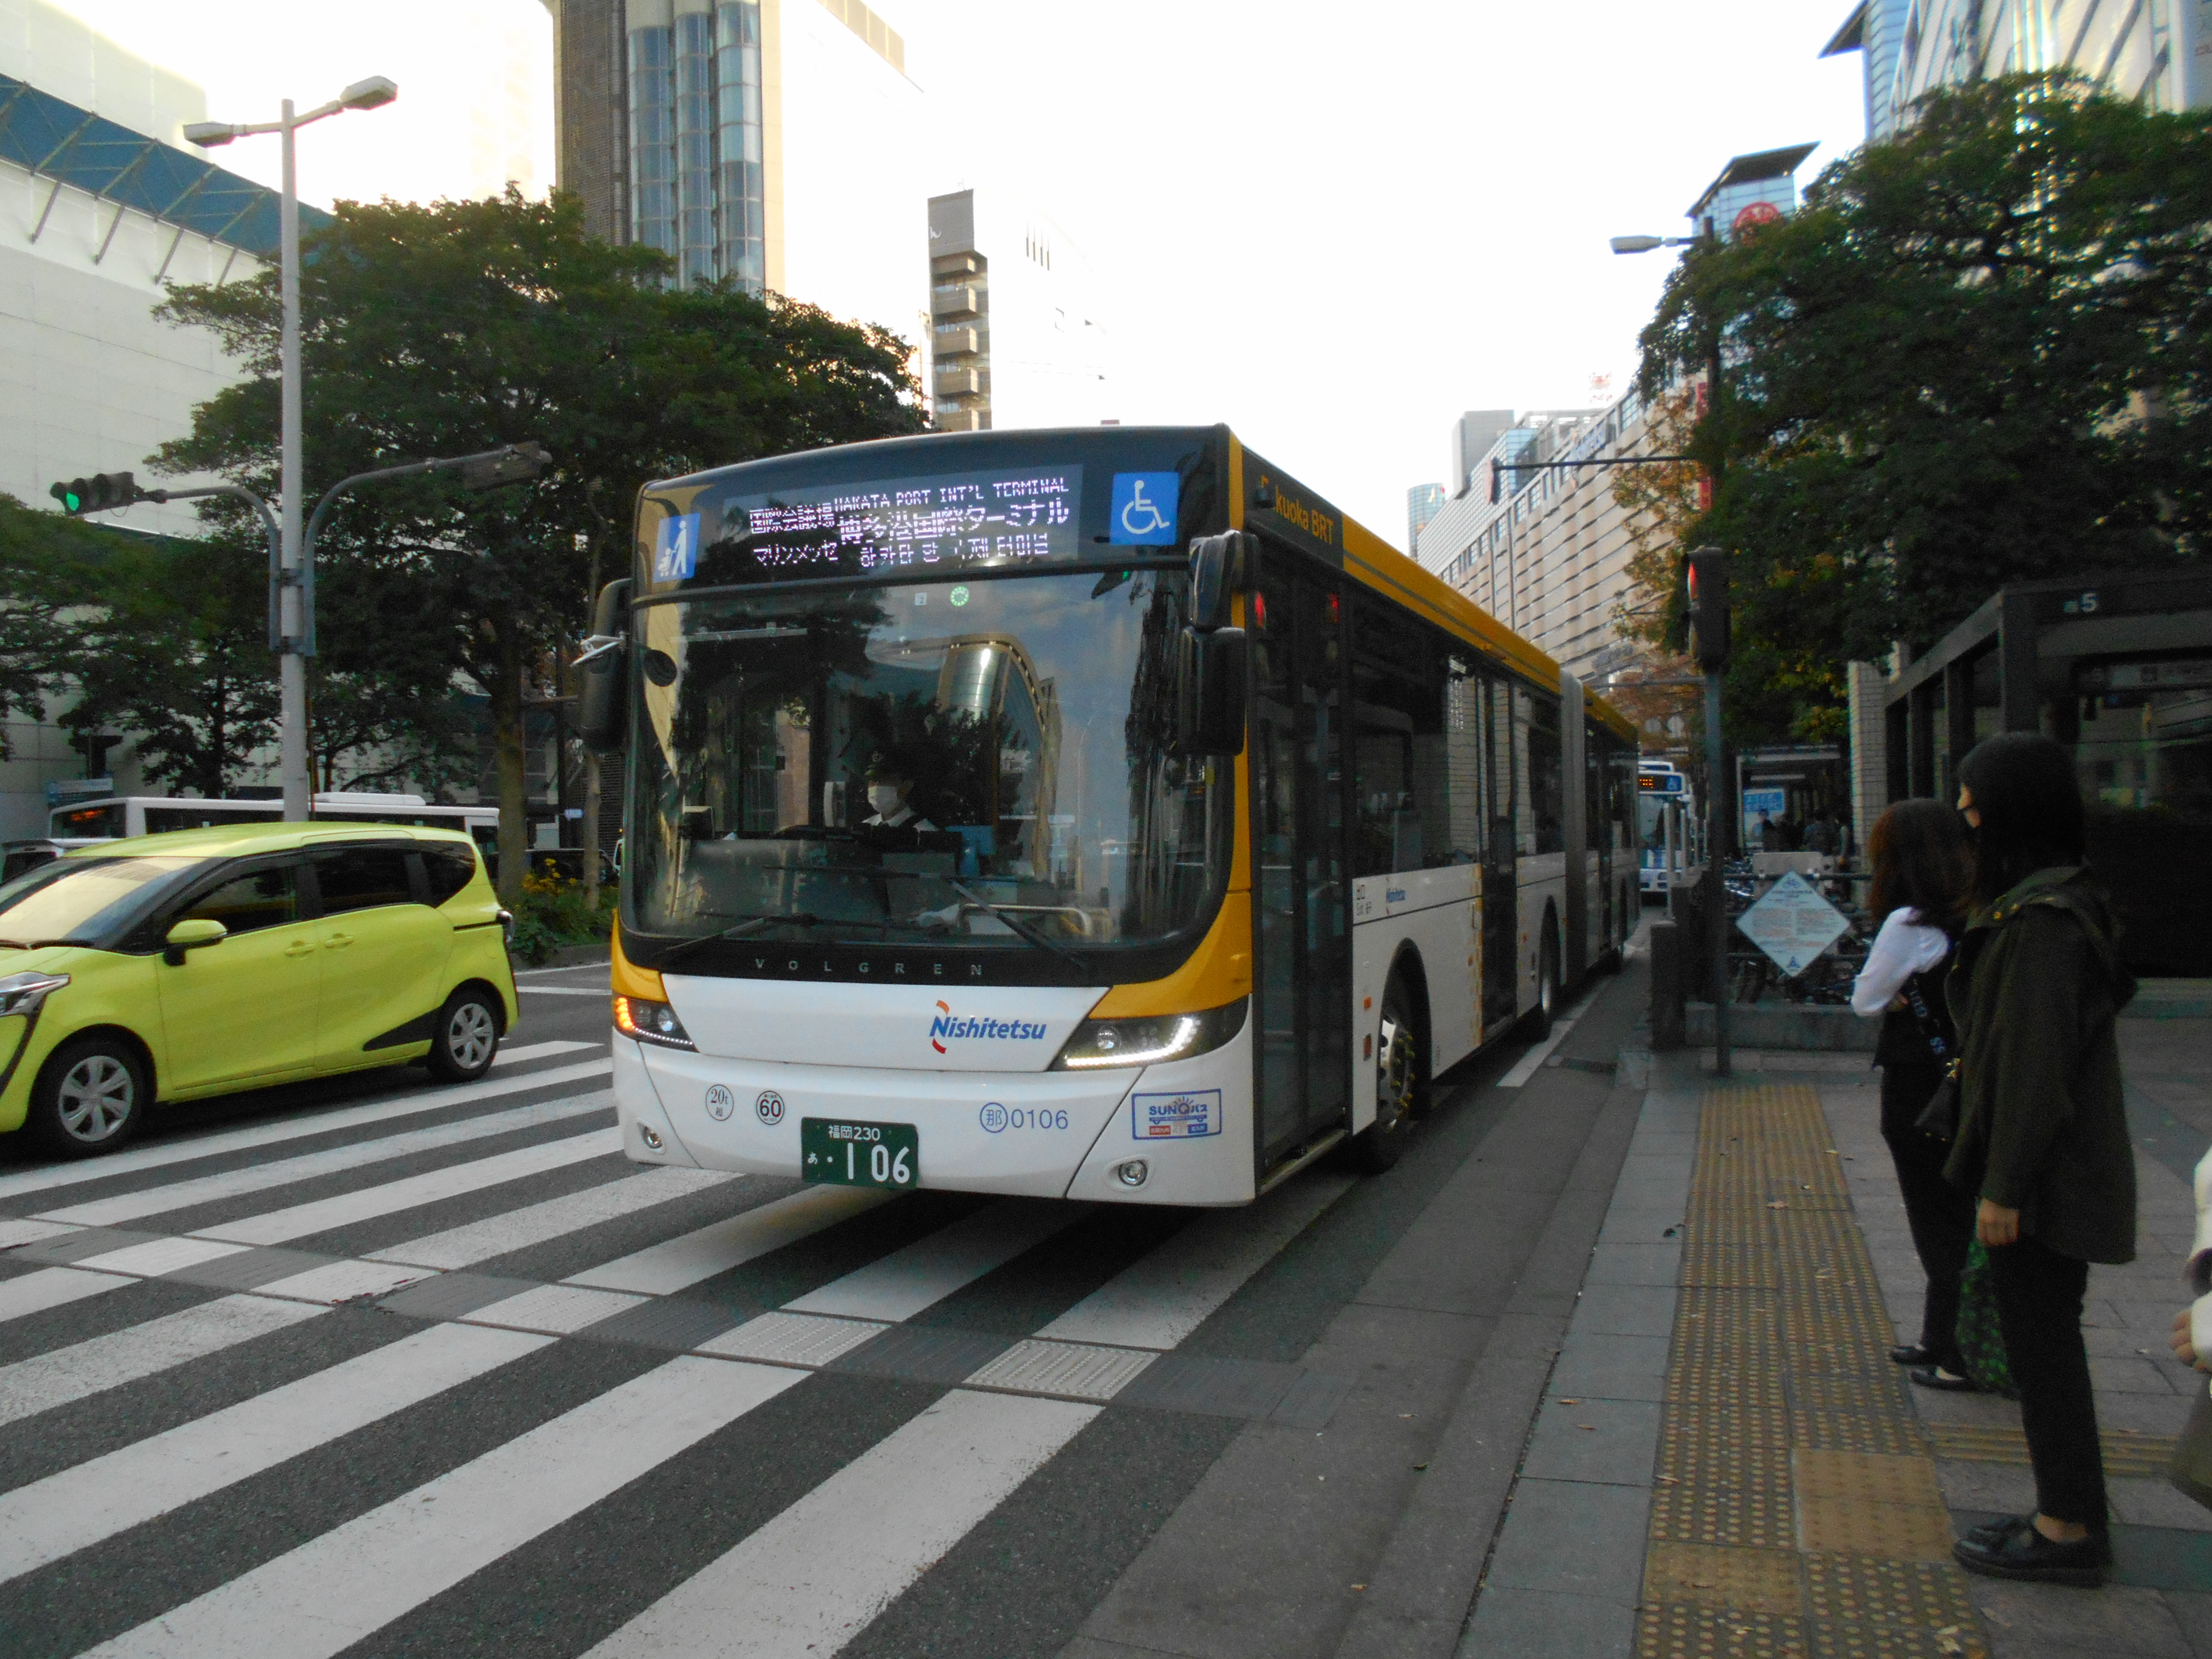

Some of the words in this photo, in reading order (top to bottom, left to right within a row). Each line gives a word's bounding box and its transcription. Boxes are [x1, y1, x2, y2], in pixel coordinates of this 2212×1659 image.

[834, 493, 890, 511] HAKATA
[896, 489, 931, 506] PORT
[993, 477, 1069, 498] TERMINAL
[1261, 475, 1309, 532] Fkuoka
[1312, 509, 1334, 545] BRT
[753, 540, 838, 567] マリンメッセ
[2081, 592, 2097, 612] 5
[755, 958, 982, 975] VOLGREN
[930, 1015, 1047, 1039] Nishitetsu
[711, 1088, 728, 1105] 20t
[760, 1098, 781, 1118] 60
[1012, 1109, 1068, 1130] 0106
[808, 1152, 818, 1164] あ
